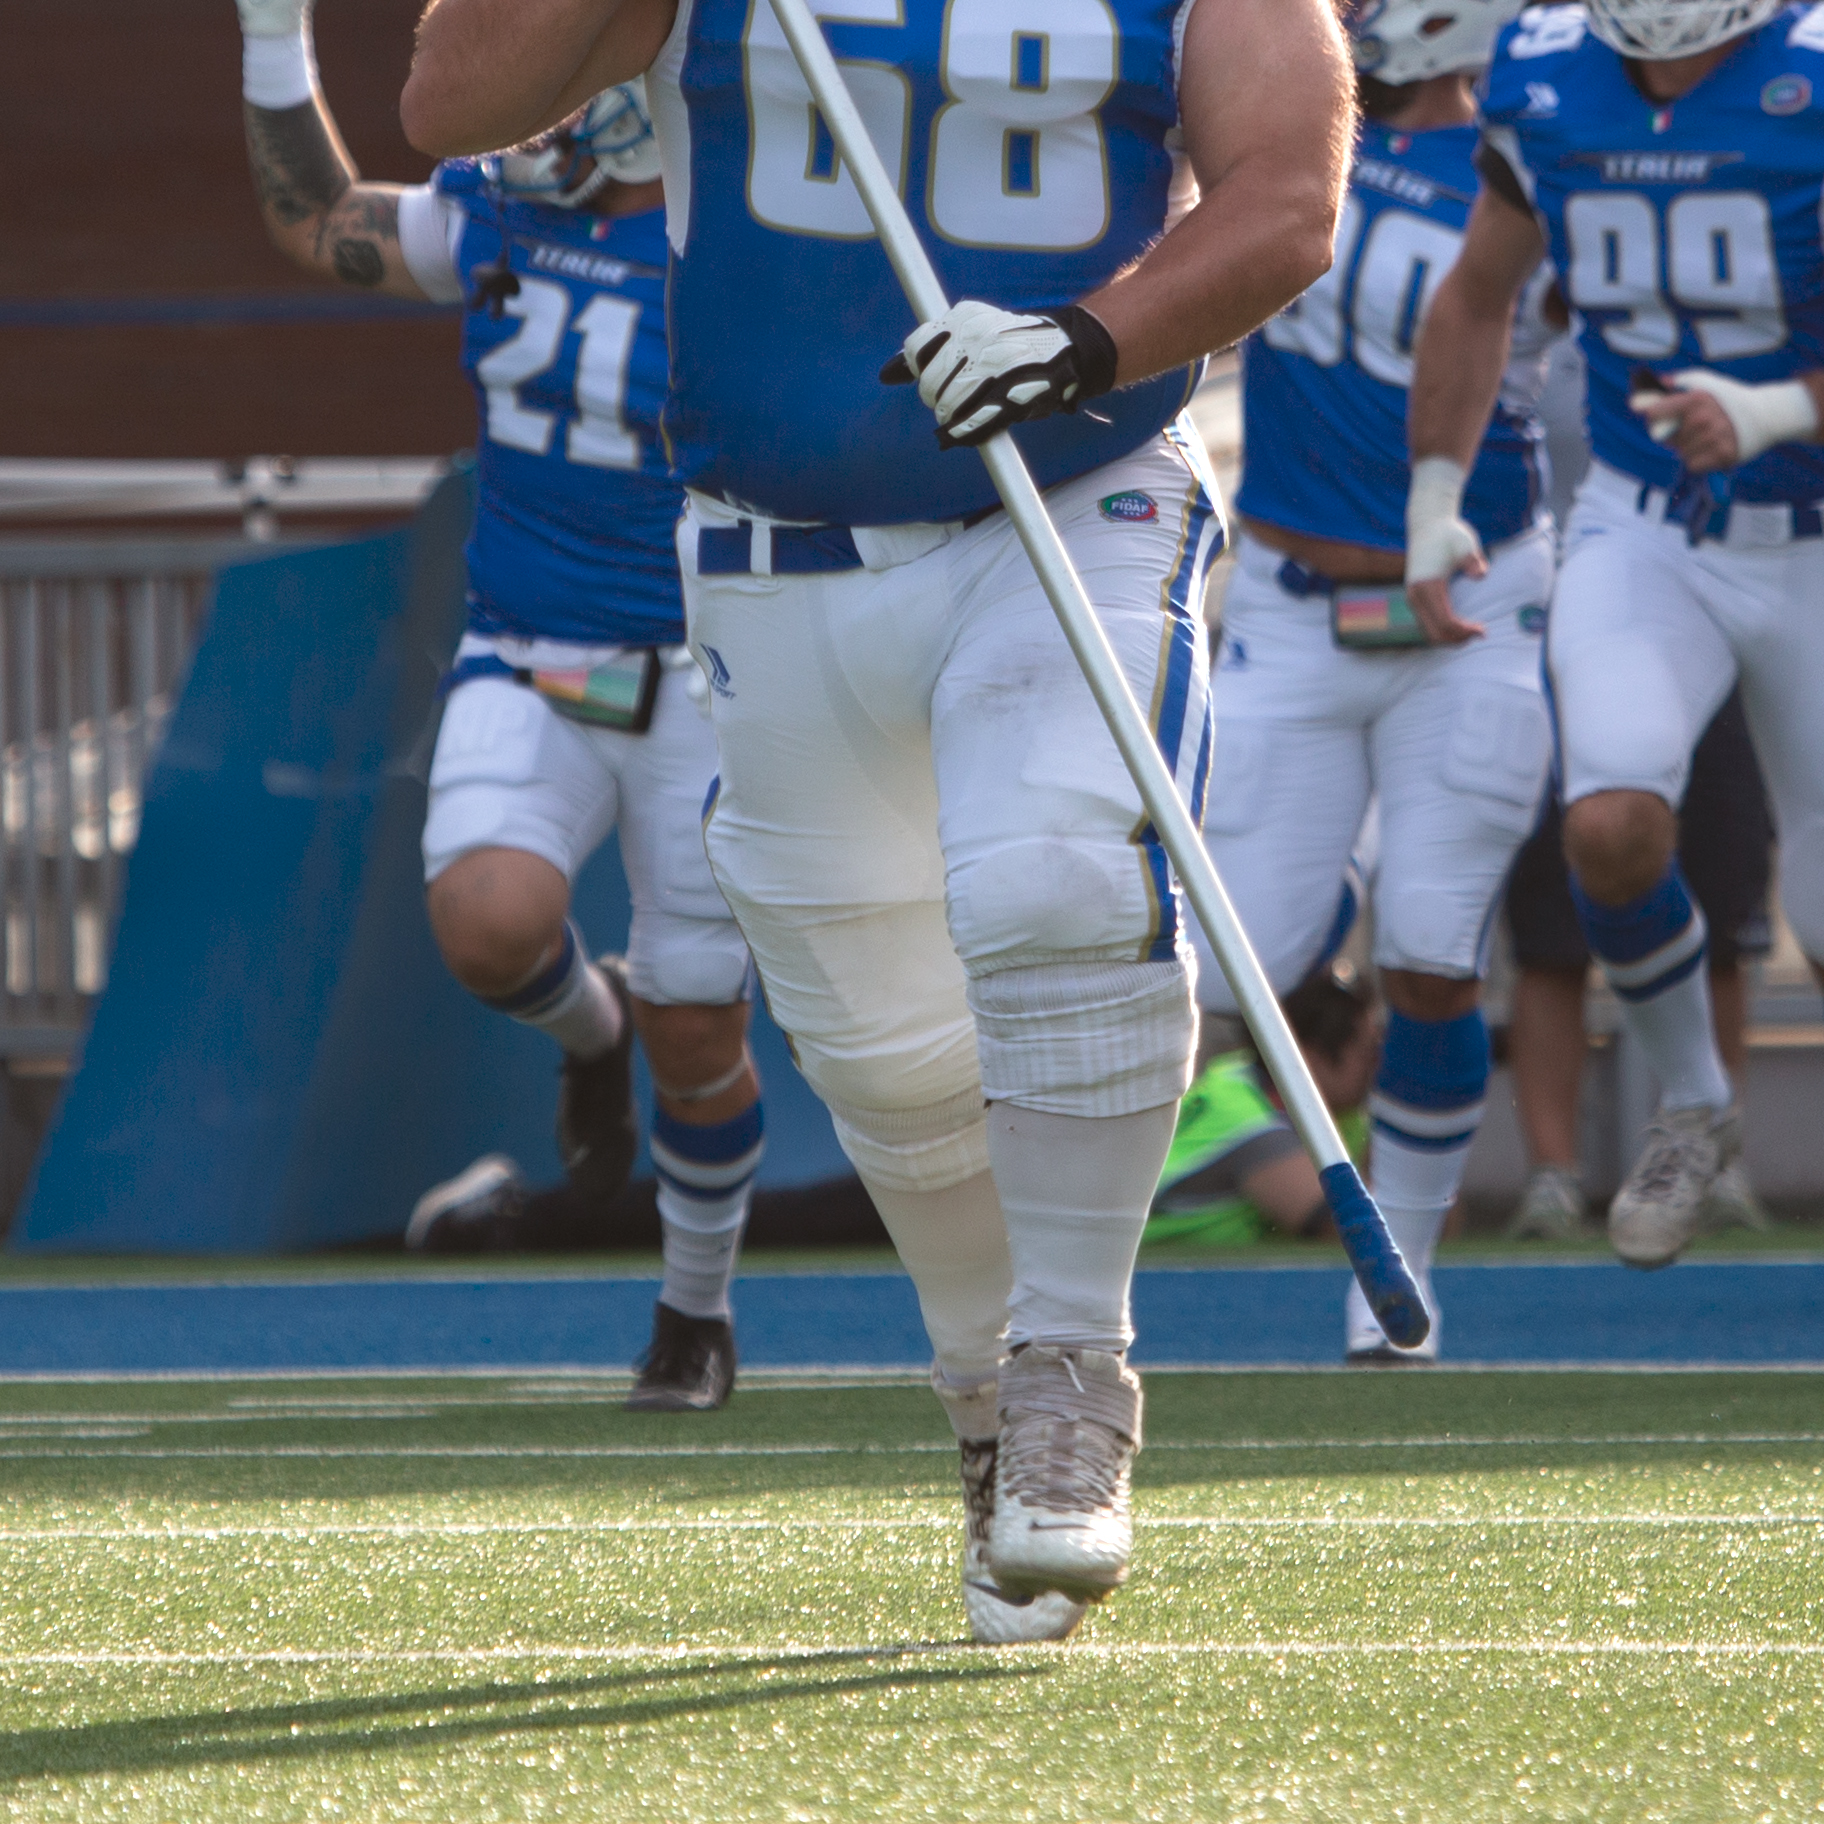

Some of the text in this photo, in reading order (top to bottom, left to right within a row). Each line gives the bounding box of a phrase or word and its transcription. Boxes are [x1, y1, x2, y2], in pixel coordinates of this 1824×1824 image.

[529, 244, 629, 285] ITALIA
[1563, 190, 1790, 362] 99
[476, 274, 643, 473] 21
